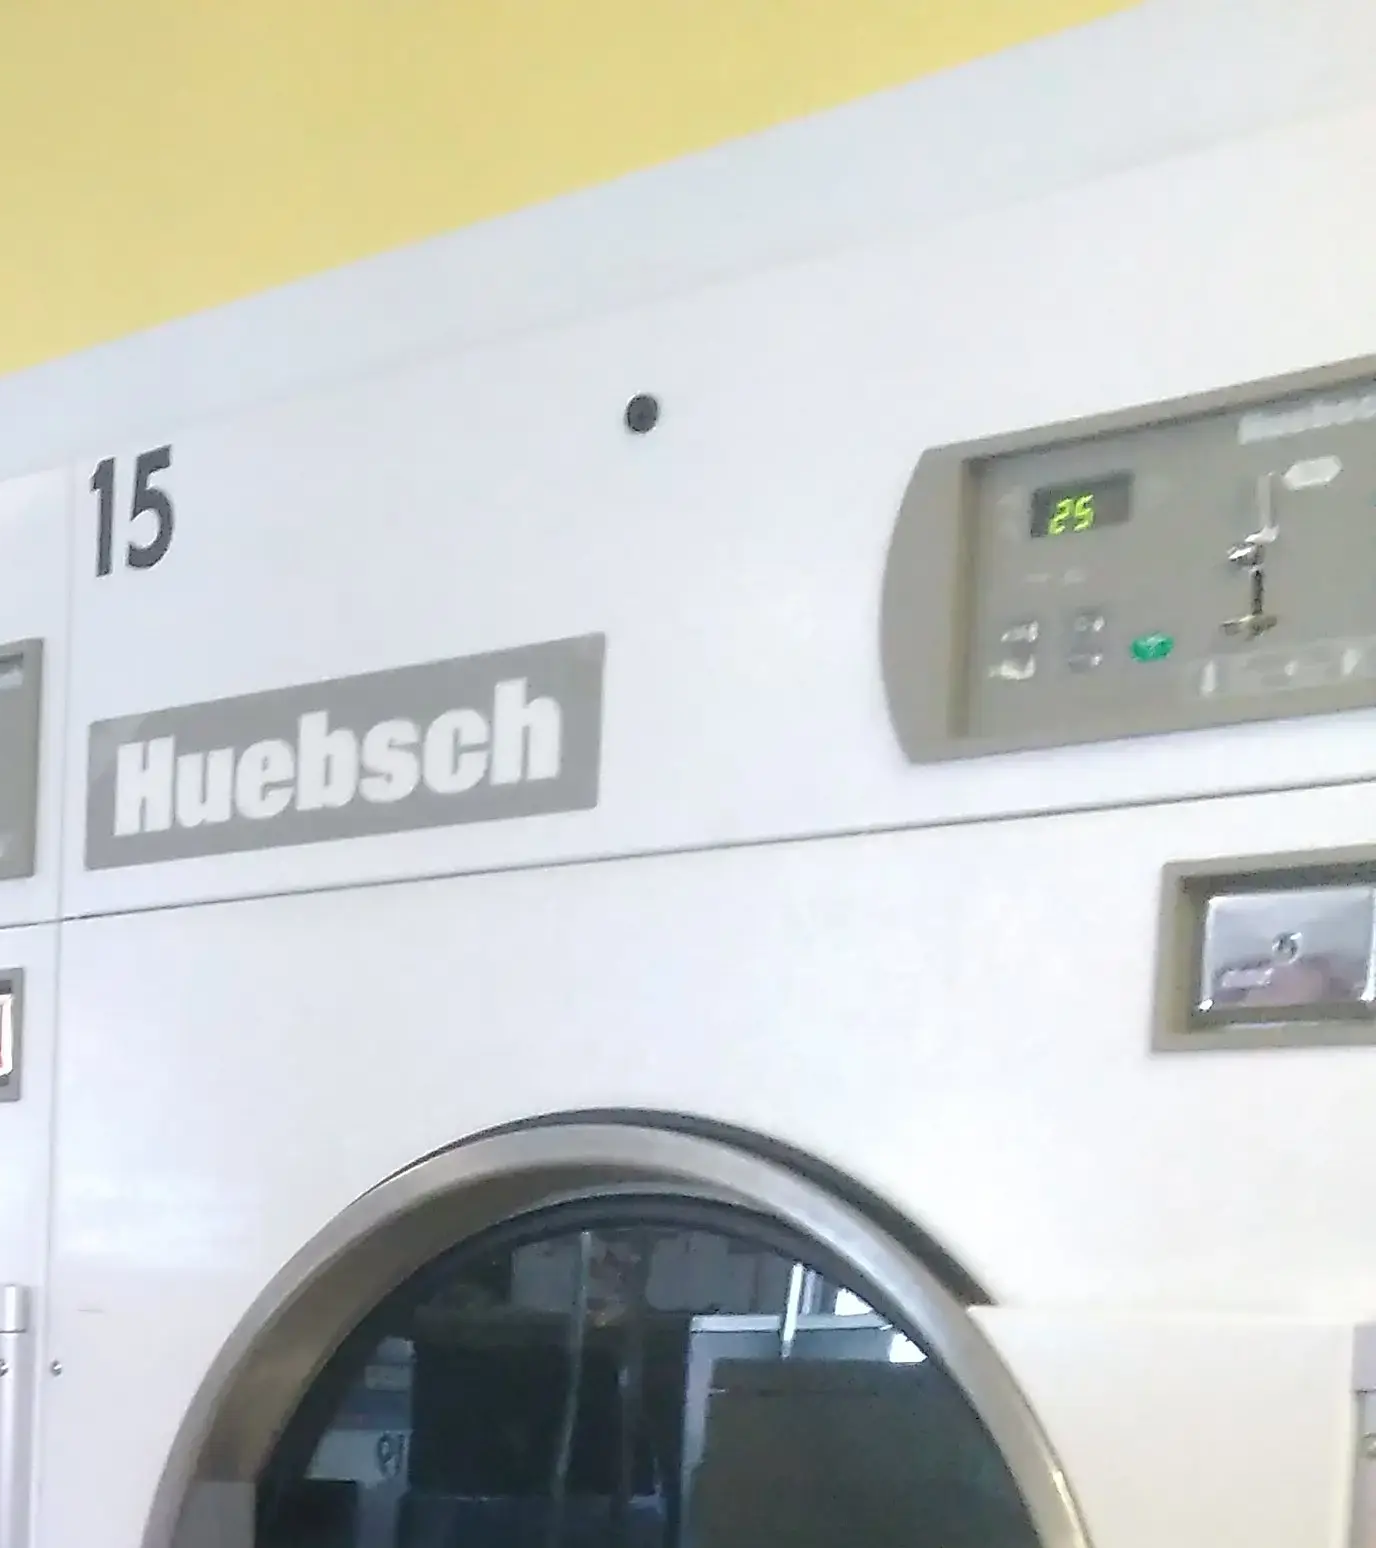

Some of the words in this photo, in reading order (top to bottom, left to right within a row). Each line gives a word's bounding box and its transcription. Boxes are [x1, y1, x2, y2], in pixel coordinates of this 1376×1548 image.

[89, 444, 174, 577] 15
[1047, 494, 1095, 536] 25
[112, 678, 562, 837] Huebsch
